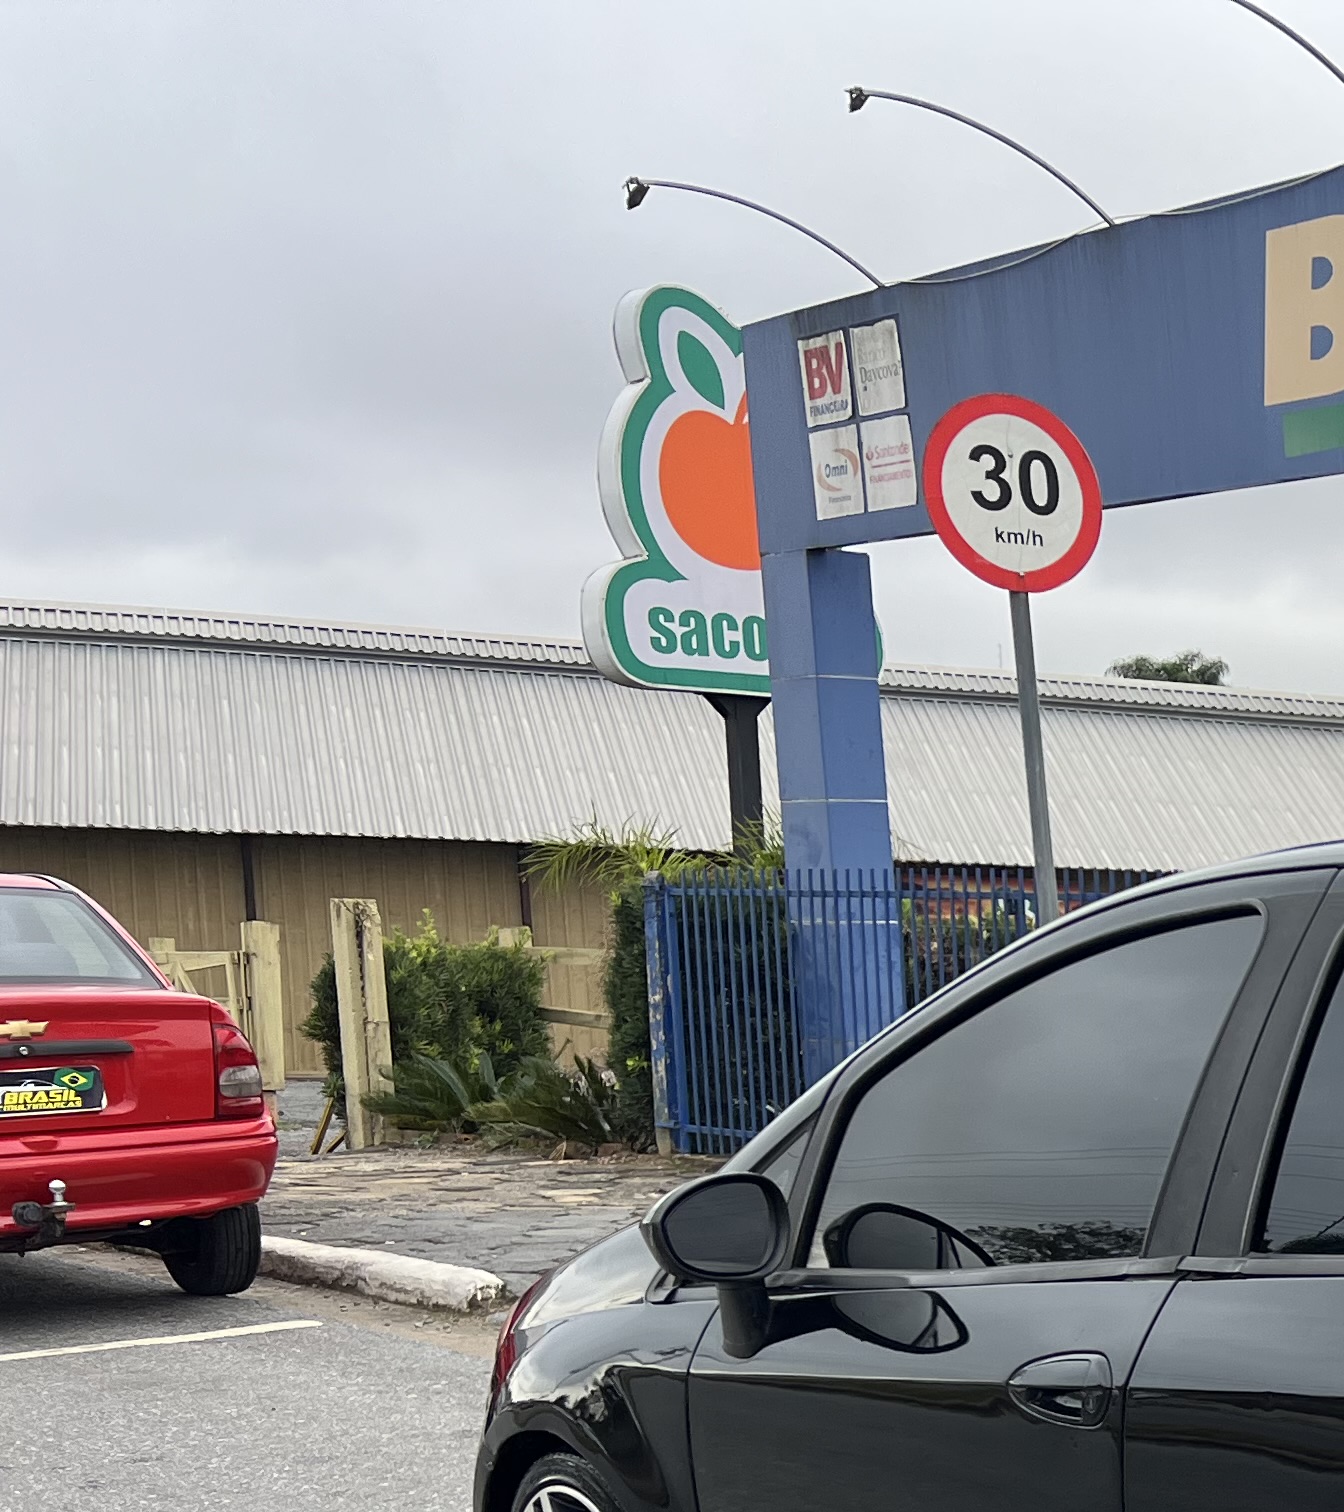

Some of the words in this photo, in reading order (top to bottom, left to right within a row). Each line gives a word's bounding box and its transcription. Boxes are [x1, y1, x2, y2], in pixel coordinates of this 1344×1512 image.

[804, 342, 844, 400] BV
[824, 459, 848, 479] Omni
[968, 444, 1060, 516] 30
[994, 526, 1044, 547] km/h
[3, 1088, 83, 1106] BRASIL
